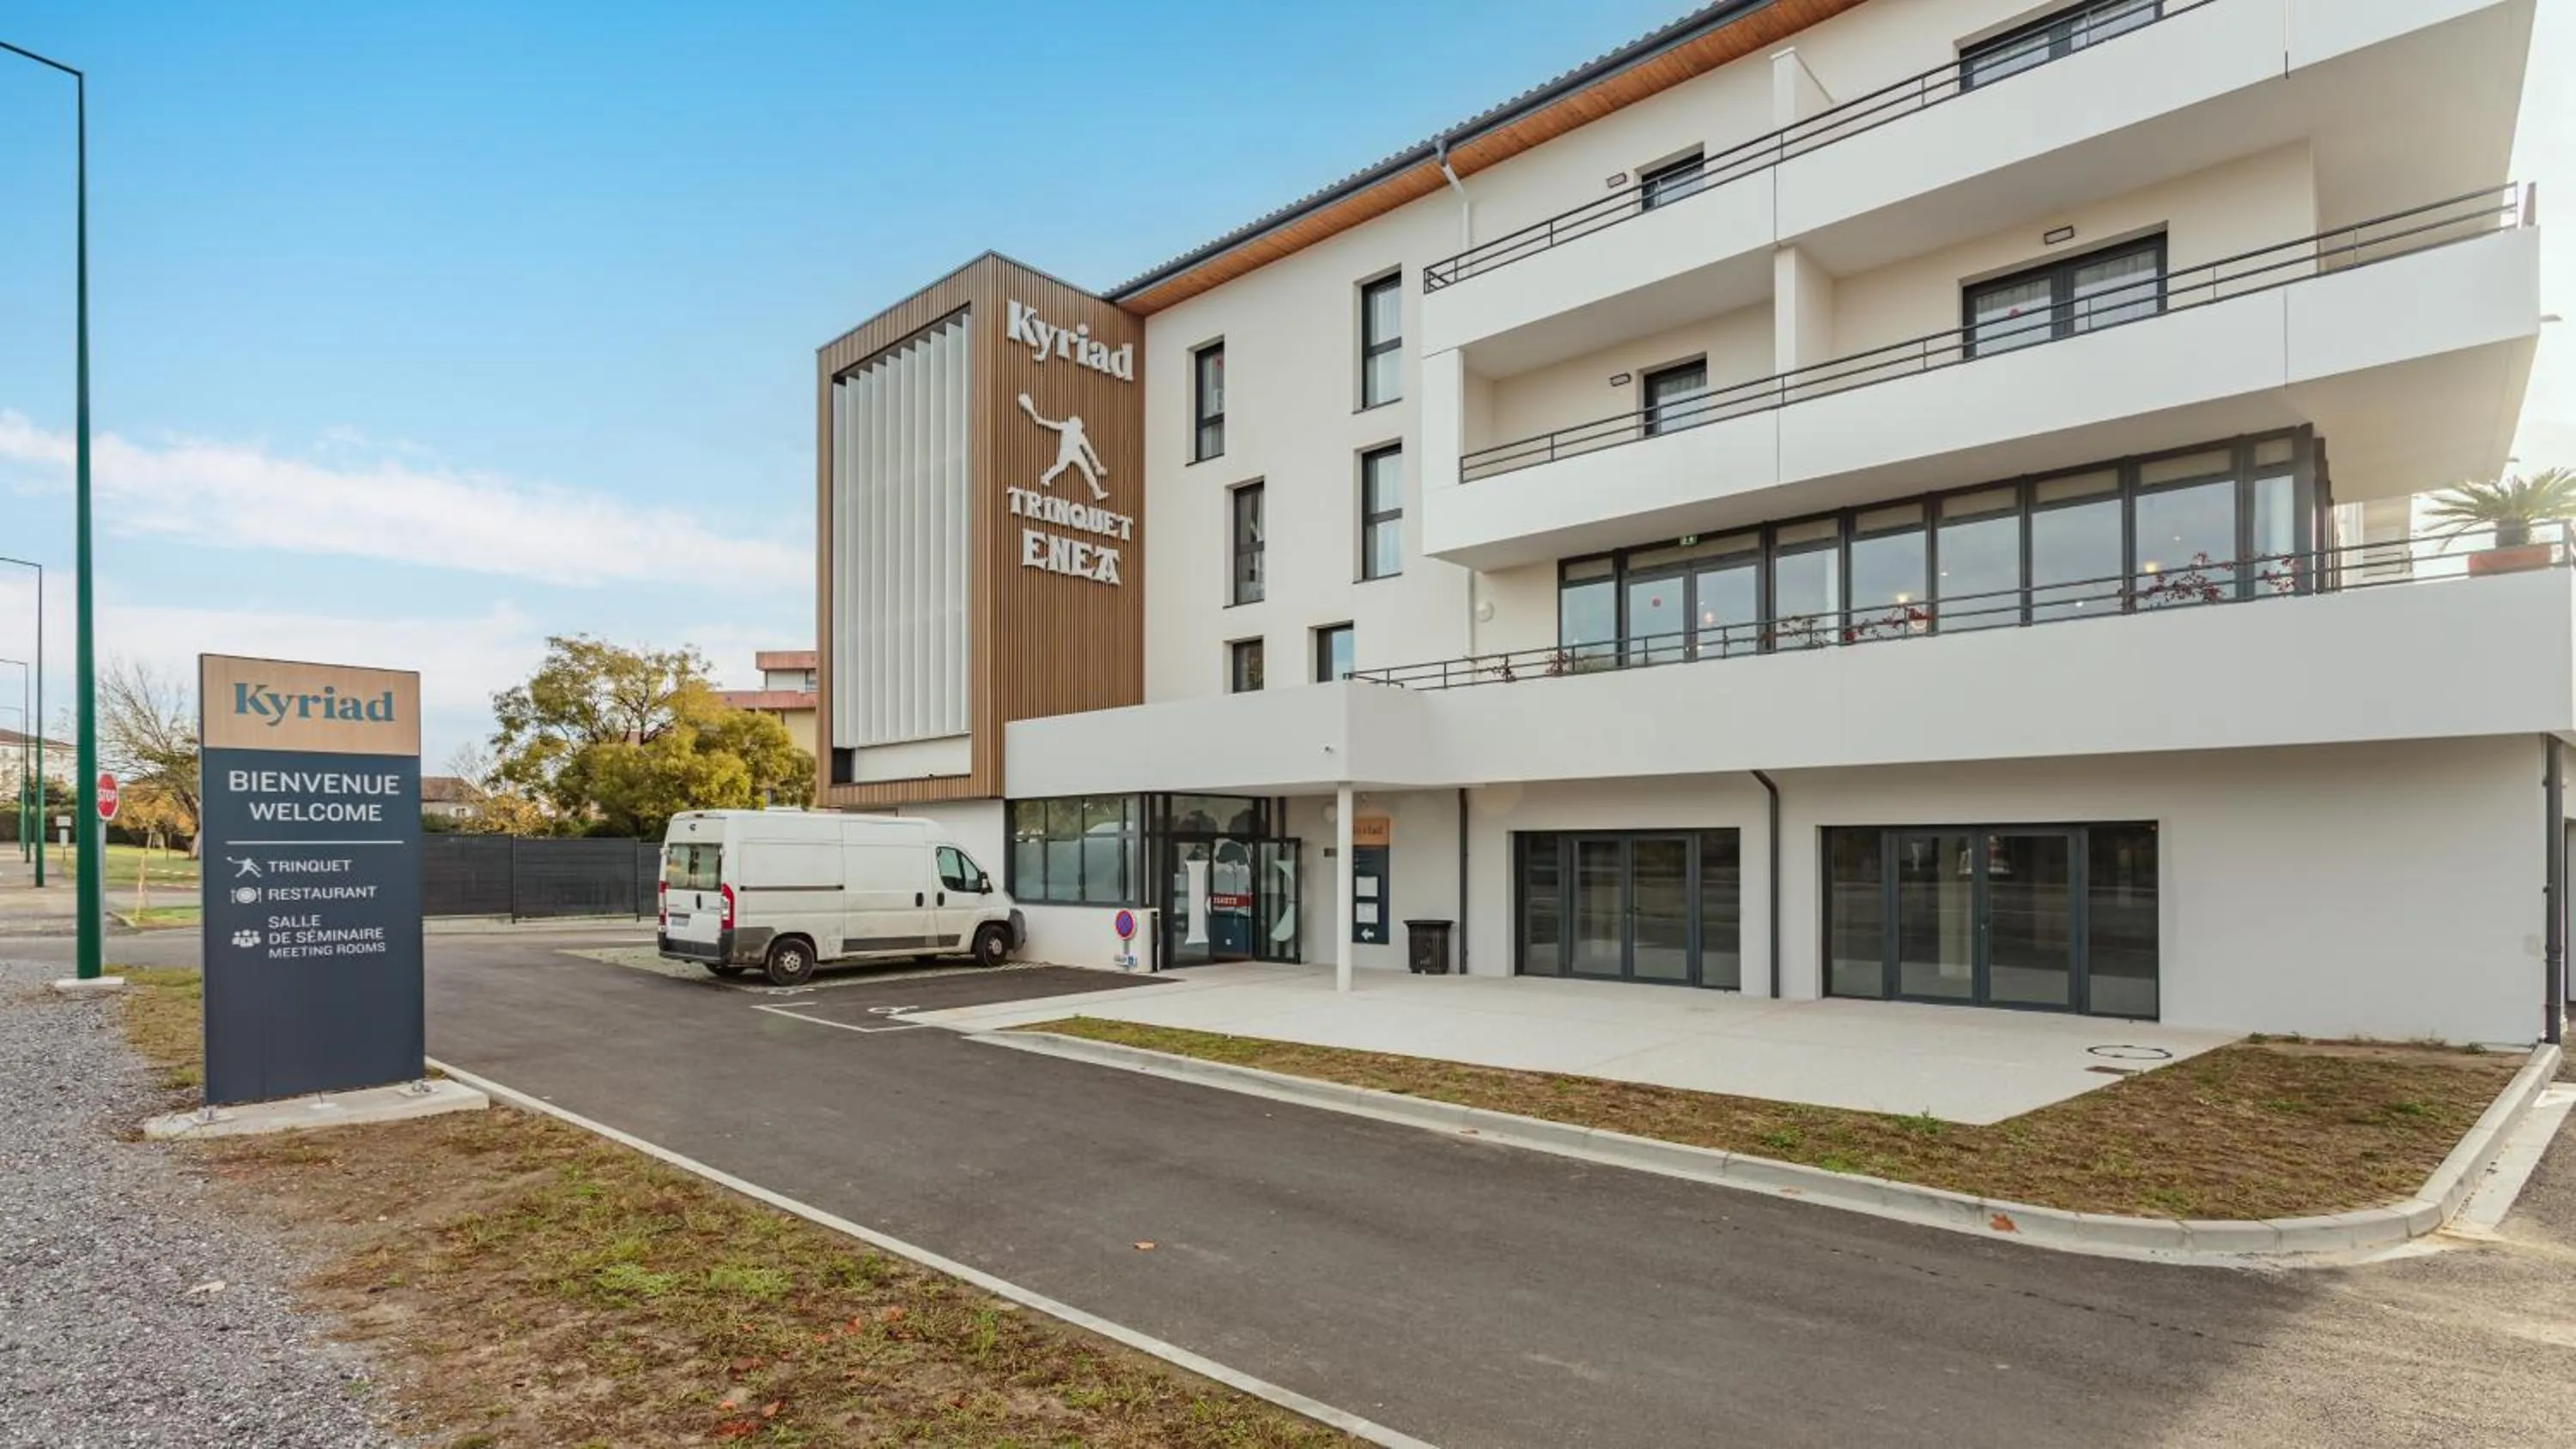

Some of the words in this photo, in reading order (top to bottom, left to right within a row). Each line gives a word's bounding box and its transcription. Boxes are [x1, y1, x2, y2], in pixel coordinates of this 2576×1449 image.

[1006, 300, 1134, 382] Kyriad
[1006, 486, 1133, 542] TRINQUET
[1022, 528, 1121, 585] ENEA
[234, 682, 395, 727] Kyriad
[228, 770, 401, 795] BIENVENUE
[97, 789, 118, 803] STOP
[249, 802, 383, 822] WELCOME
[267, 859, 353, 874] TRINQUET
[268, 886, 378, 900] RESTAURANT
[268, 914, 322, 929] SALLE
[269, 931, 292, 945] DE
[295, 927, 385, 944] SÉMINAIRE
[269, 945, 333, 960] MEETING
[336, 941, 386, 955] ROOMS
